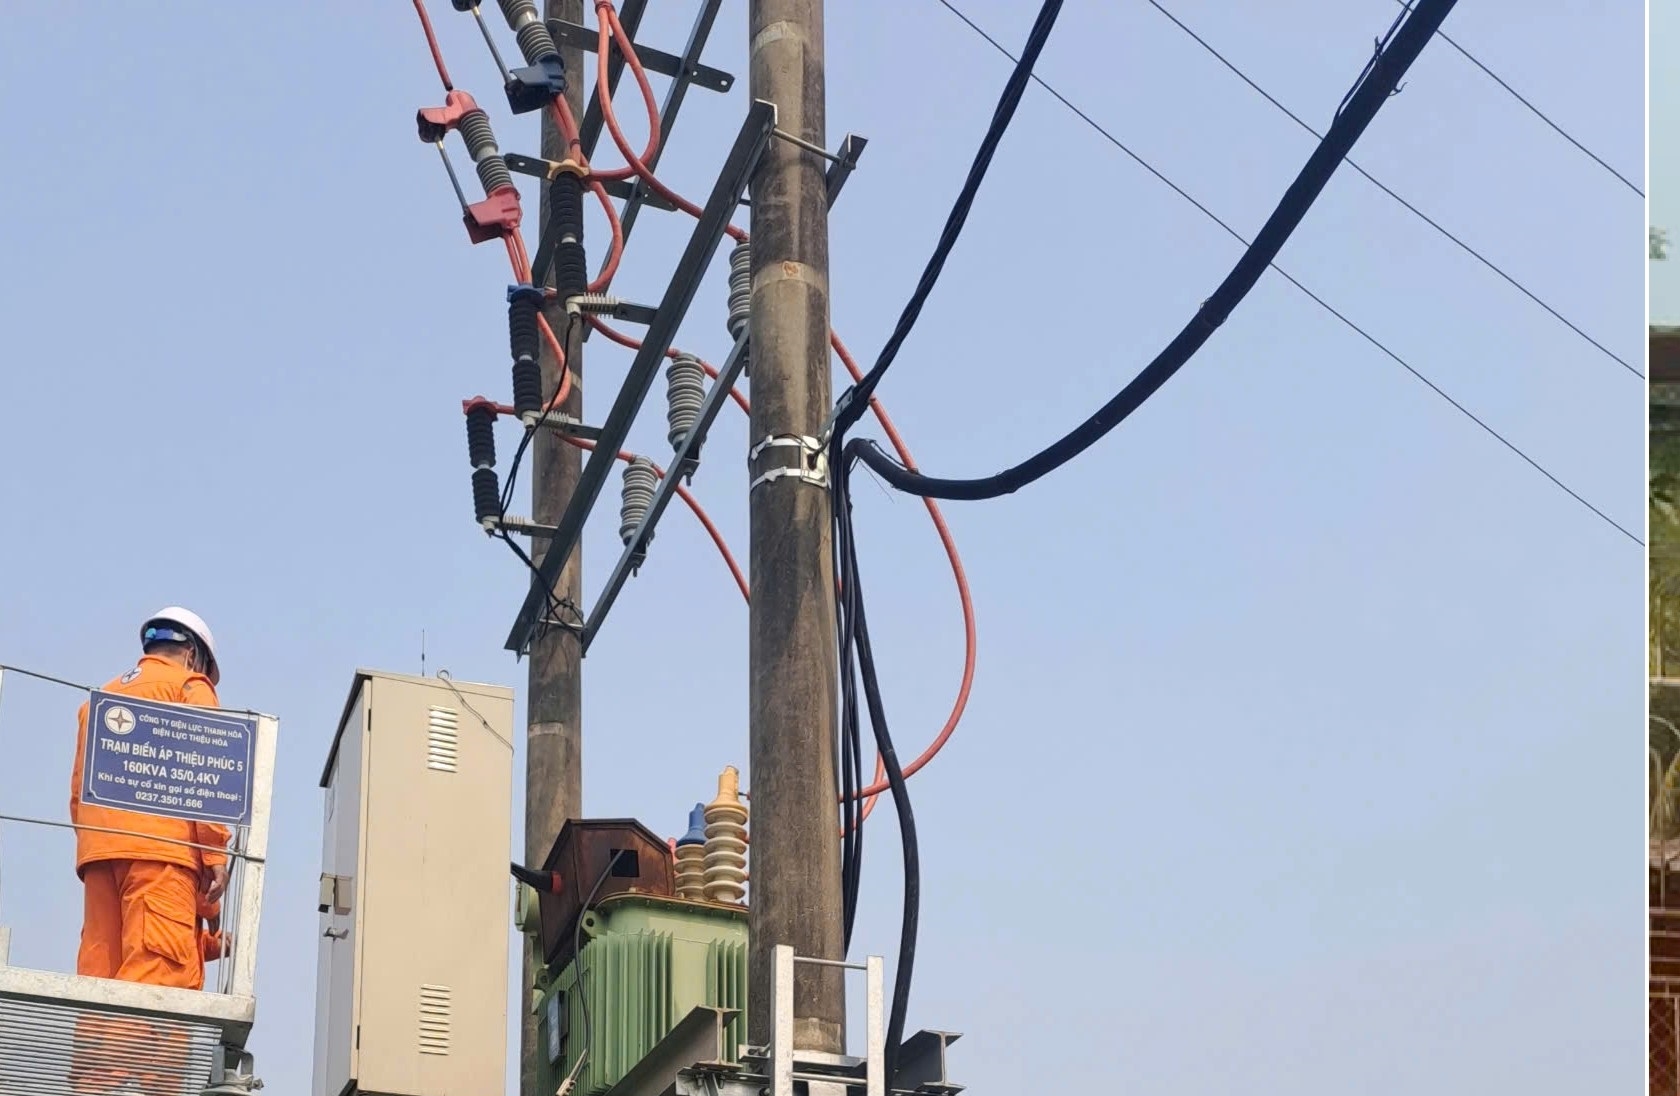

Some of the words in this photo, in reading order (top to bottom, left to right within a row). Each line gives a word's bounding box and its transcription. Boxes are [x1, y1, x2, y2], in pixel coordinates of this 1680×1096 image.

[139, 714, 159, 724] CÔNG
[161, 718, 170, 726] TY
[188, 724, 203, 733] LỰC
[204, 726, 227, 737] THANH
[152, 728, 170, 737] ĐIỆN
[172, 731, 188, 741] LỰC
[189, 734, 211, 744] THIỆU
[101, 738, 130, 755] TRẠM
[132, 741, 157, 759] BIẾN
[158, 745, 173, 761] ÁP
[175, 751, 205, 768] THIỆU
[207, 755, 235, 771] PHÚC
[236, 761, 244, 772] 5
[123, 760, 167, 778] 160KVA
[170, 768, 220, 785] 35/0,4KV
[98, 772, 113, 782] Khi
[114, 776, 126, 784] có
[127, 779, 140, 788] sự
[140, 779, 153, 788] cố
[154, 782, 167, 791] xin
[168, 785, 182, 795] gọi
[184, 786, 196, 795] số
[197, 788, 215, 799] điện
[136, 791, 203, 809] 0237.3501.666
